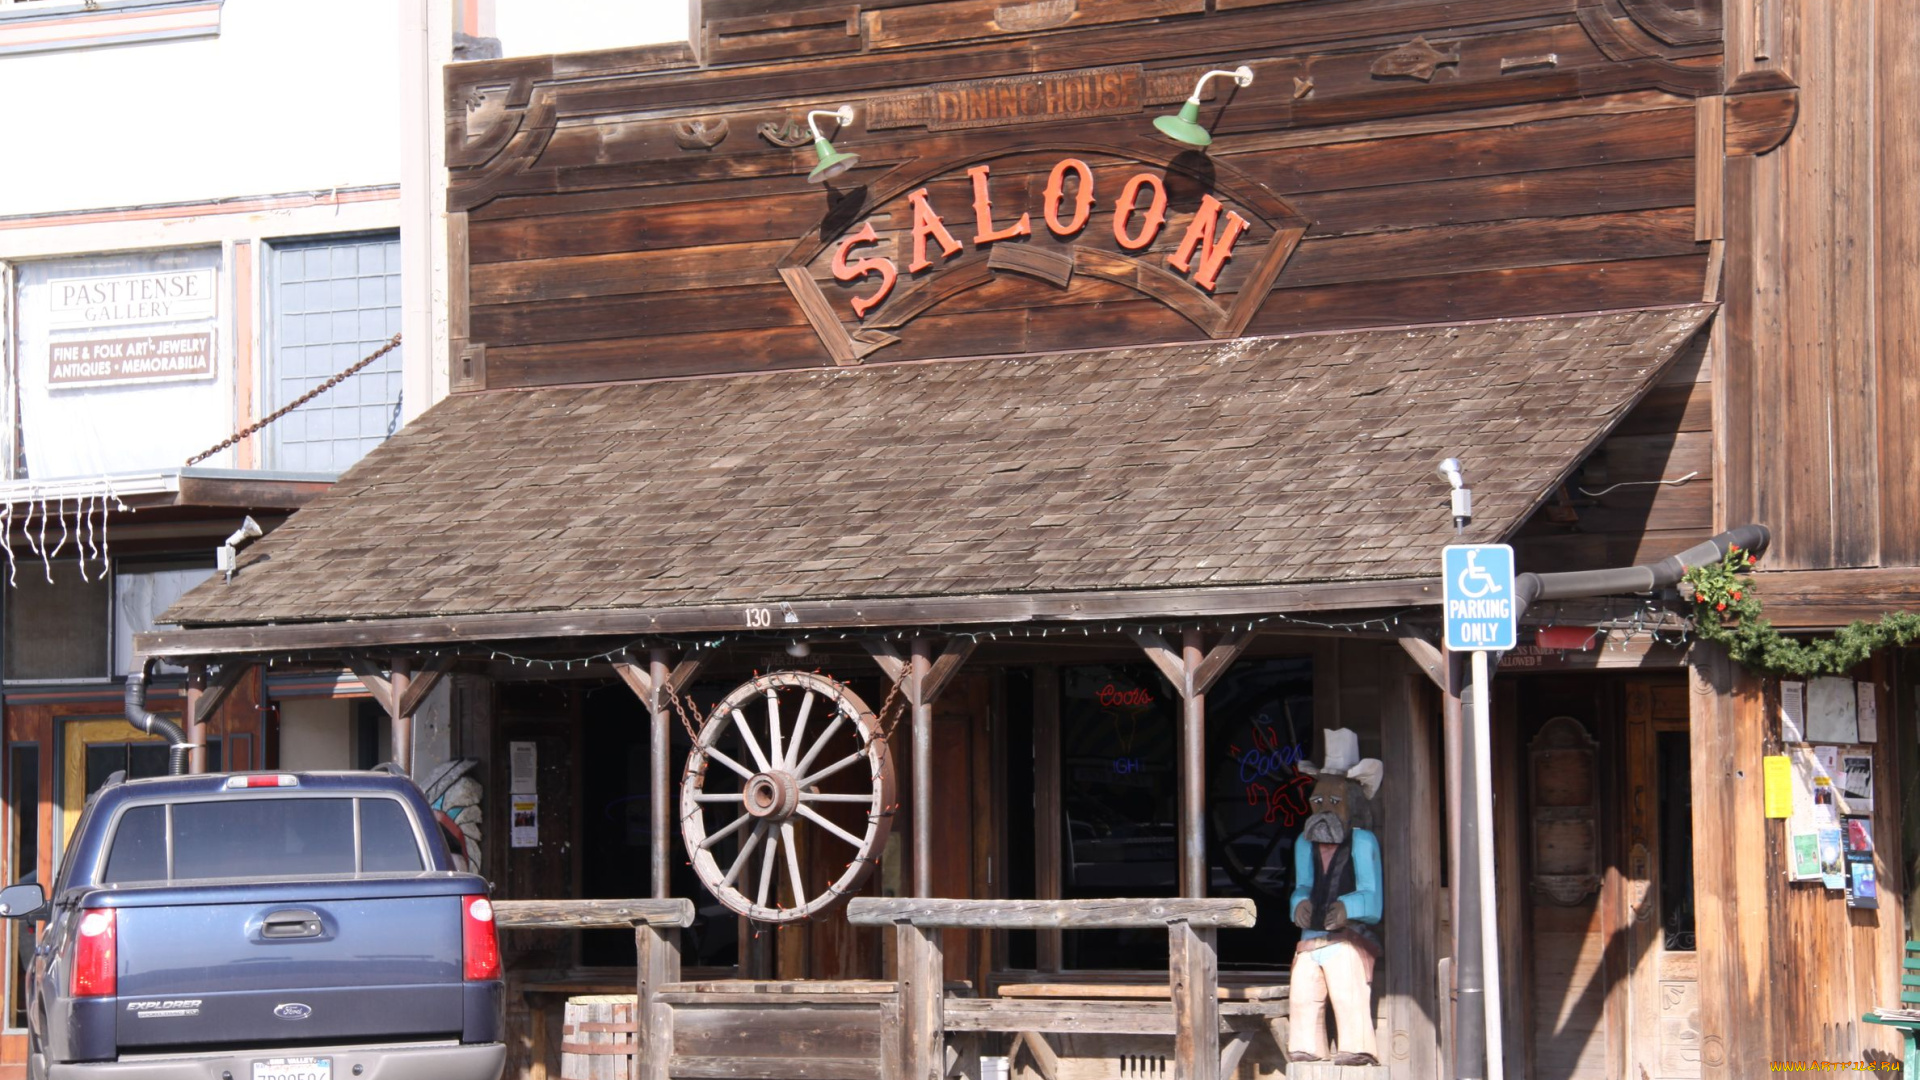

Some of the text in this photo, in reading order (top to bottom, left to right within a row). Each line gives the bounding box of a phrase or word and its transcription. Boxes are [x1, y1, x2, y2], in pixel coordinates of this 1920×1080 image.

[938, 70, 1140, 122] DINING HOUSE
[832, 158, 1251, 318] SALOON
[63, 274, 199, 306] PAST TENSE
[84, 301, 173, 322] GALLERY
[53, 337, 207, 361] FINE & FOLK ART JEWELRY
[53, 354, 207, 379] ANTIQUES MEMORABILIA
[745, 608, 771, 627] 130
[1450, 598, 1509, 619] PARKING
[1460, 622, 1499, 643] ONLY
[1095, 684, 1154, 706] Coors
[1239, 743, 1304, 783] Coors
[126, 1000, 203, 1011] EXPLORER
